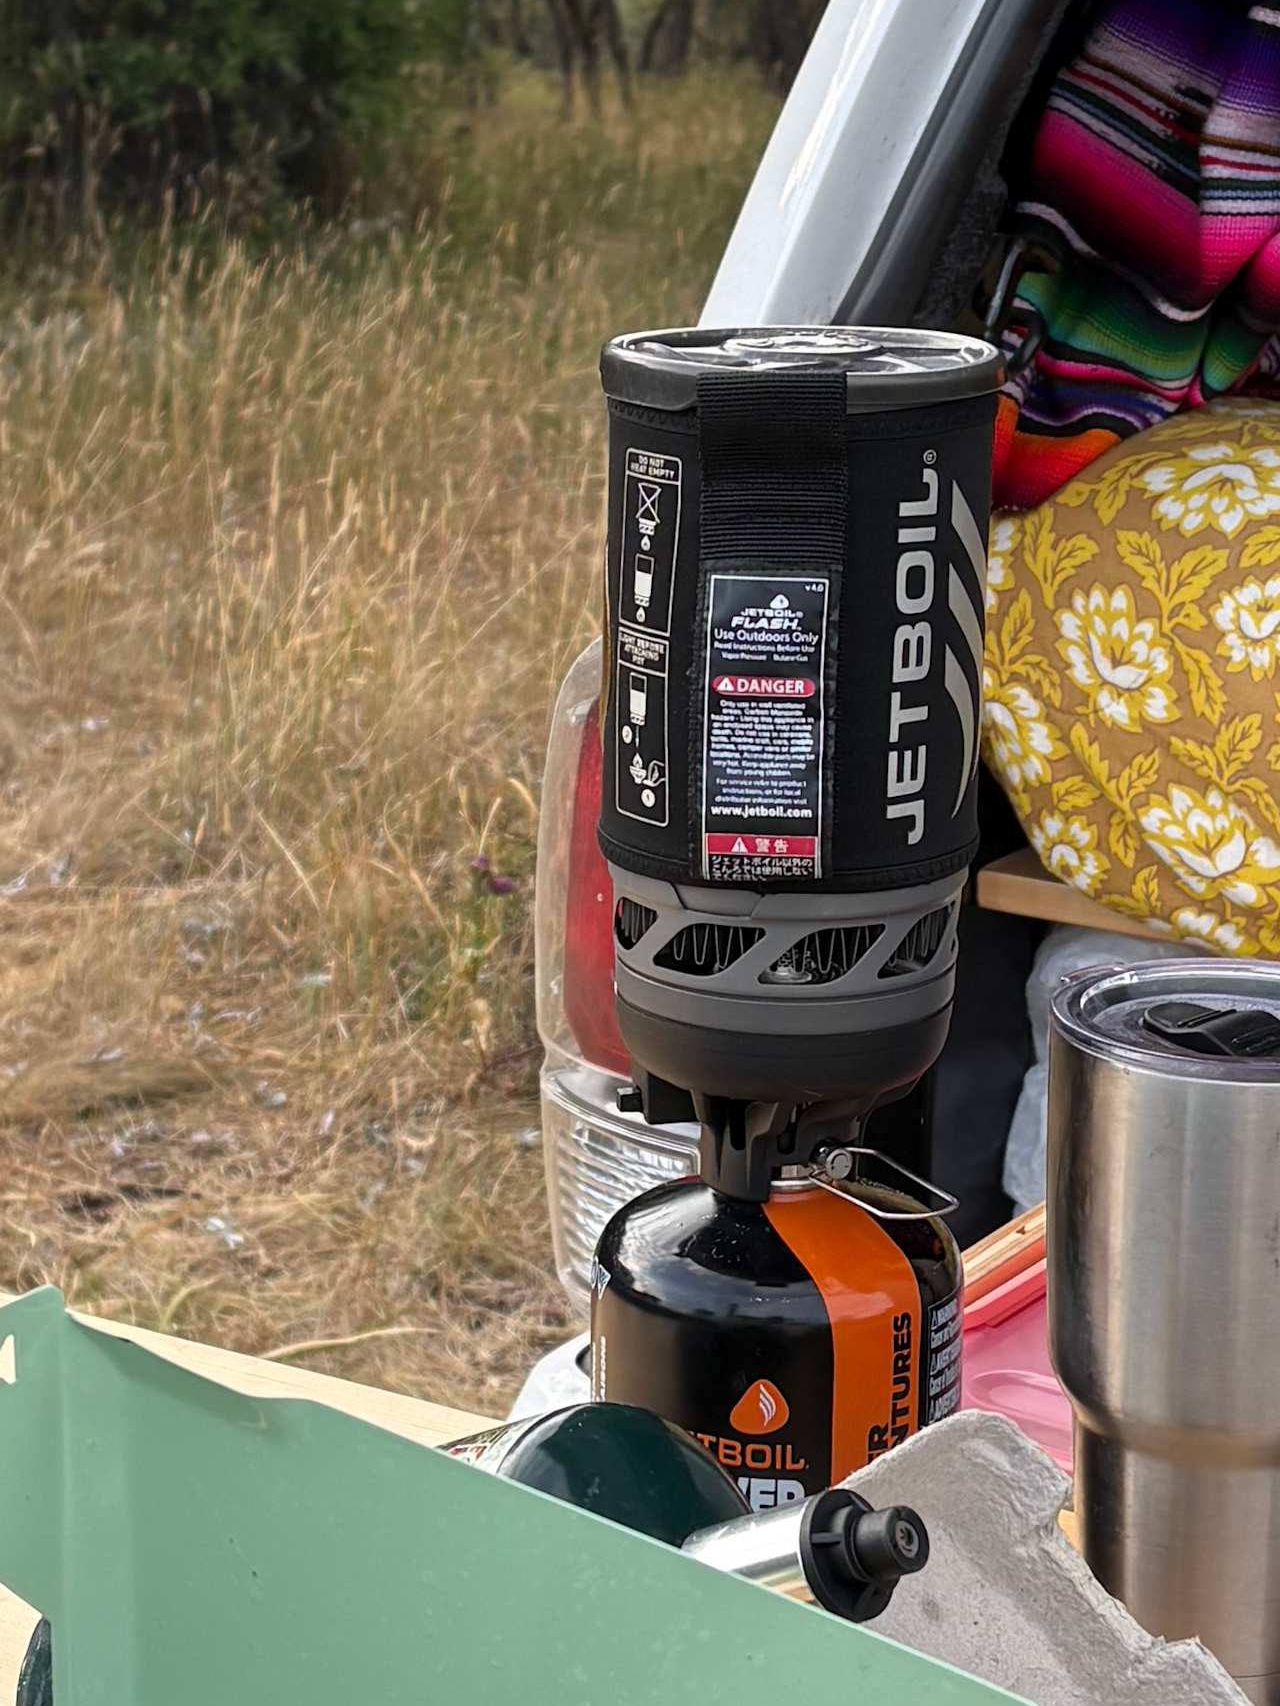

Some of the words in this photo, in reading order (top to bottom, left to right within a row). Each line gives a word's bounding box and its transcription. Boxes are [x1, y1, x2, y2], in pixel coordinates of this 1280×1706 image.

[715, 629, 735, 640] Use
[737, 630, 790, 642] Outdoors
[792, 632, 819, 645] Only
[737, 678, 805, 693] DANGER
[755, 838, 789, 853] 警告
